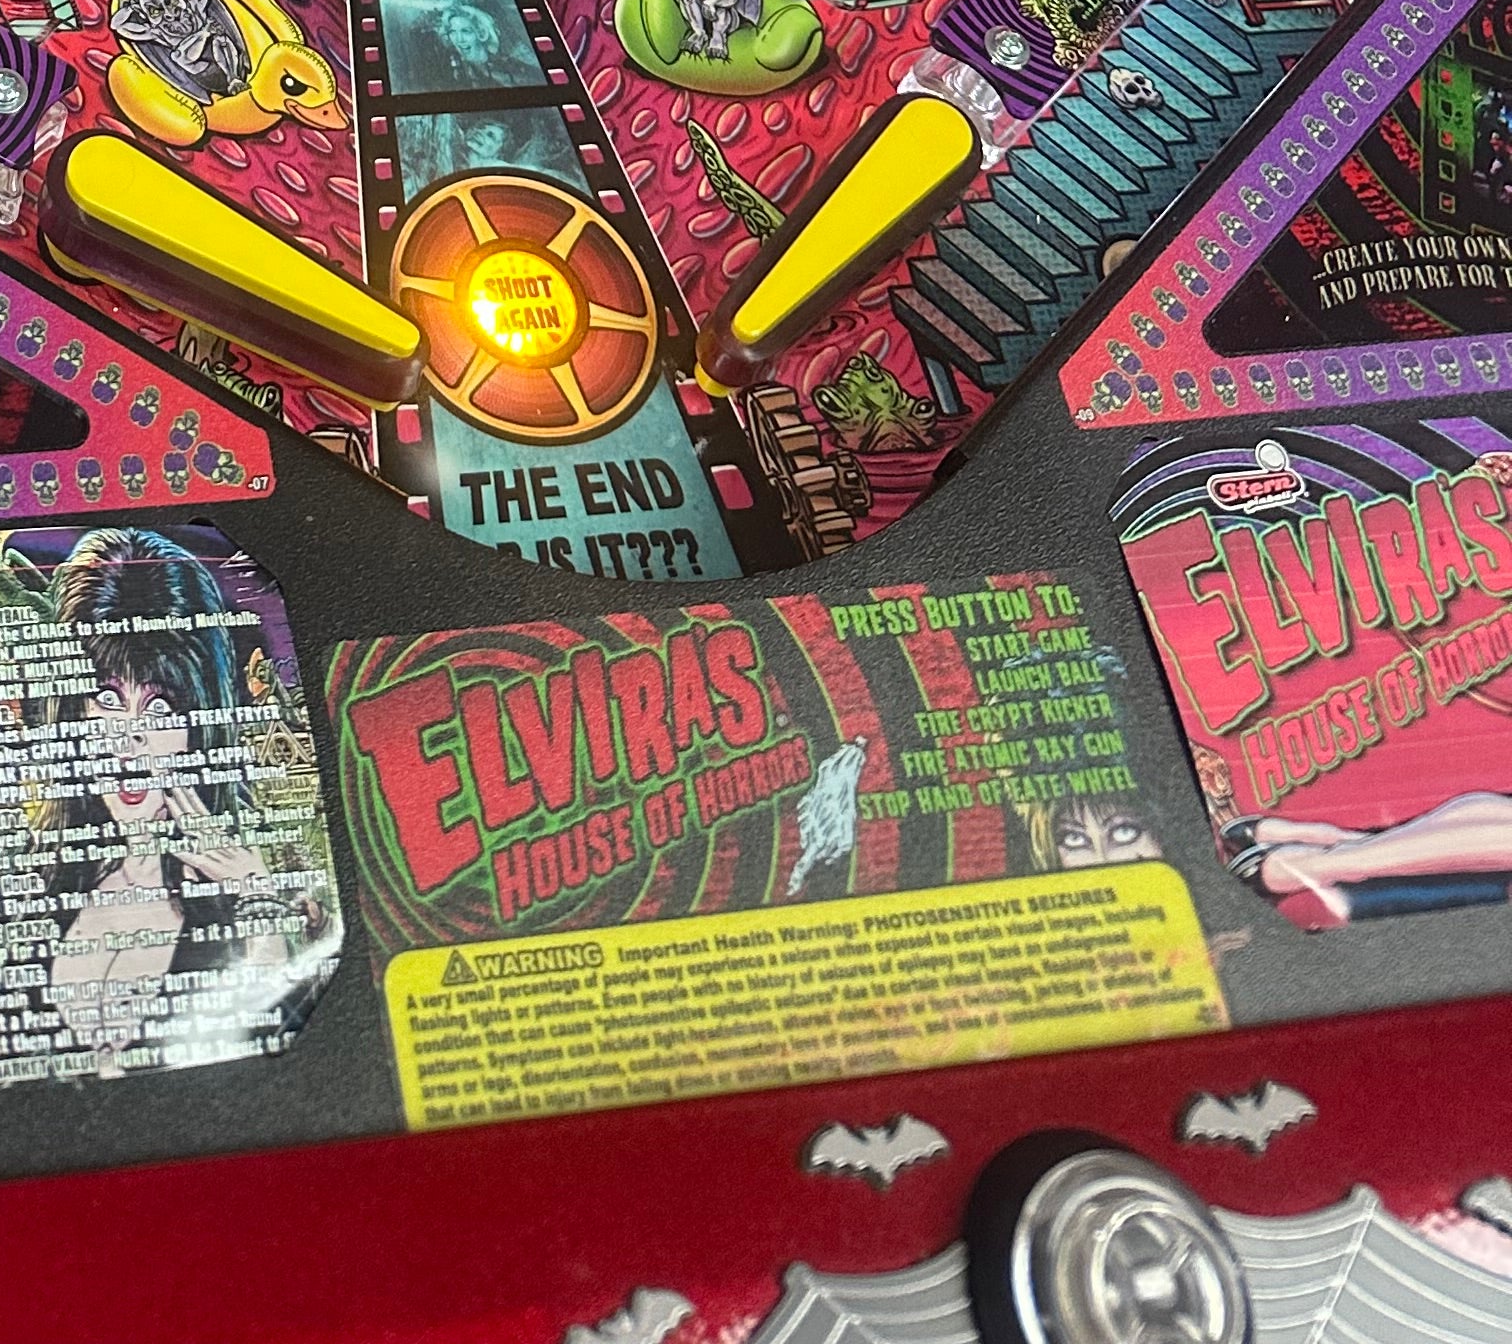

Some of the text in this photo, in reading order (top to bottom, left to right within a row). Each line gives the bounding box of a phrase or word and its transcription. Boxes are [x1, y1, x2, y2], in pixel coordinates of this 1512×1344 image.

[1402, 235, 1459, 260] YOUR
[483, 273, 552, 303] SHOOT
[1319, 264, 1497, 310] AND PREPARE FOR
[496, 305, 562, 334] AGAIN
[247, 475, 269, 491] -07
[459, 457, 685, 526] THE END
[1218, 475, 1294, 501] Stern
[585, 527, 700, 580] IT???
[831, 584, 1084, 640] PRESS BUTTON TO:
[1123, 472, 1512, 732] ELVIRA'S
[965, 626, 1092, 661] START GAME
[976, 660, 1106, 695] LAUNCH BALL
[914, 693, 1114, 737] FIRE CRYPT KICKER
[1245, 657, 1421, 806] HOUSE OF
[349, 622, 769, 895] ELVIRA'S
[900, 730, 1125, 776] FIRE ATOMIC RAY GUN
[858, 765, 1137, 821] STOP HAND OF WHEEL
[492, 735, 812, 921] HOUSE OF HORRORS
[475, 887, 1118, 980] WARNING Important Health Warning: PHOTOSENSITIVE SEIZURES
